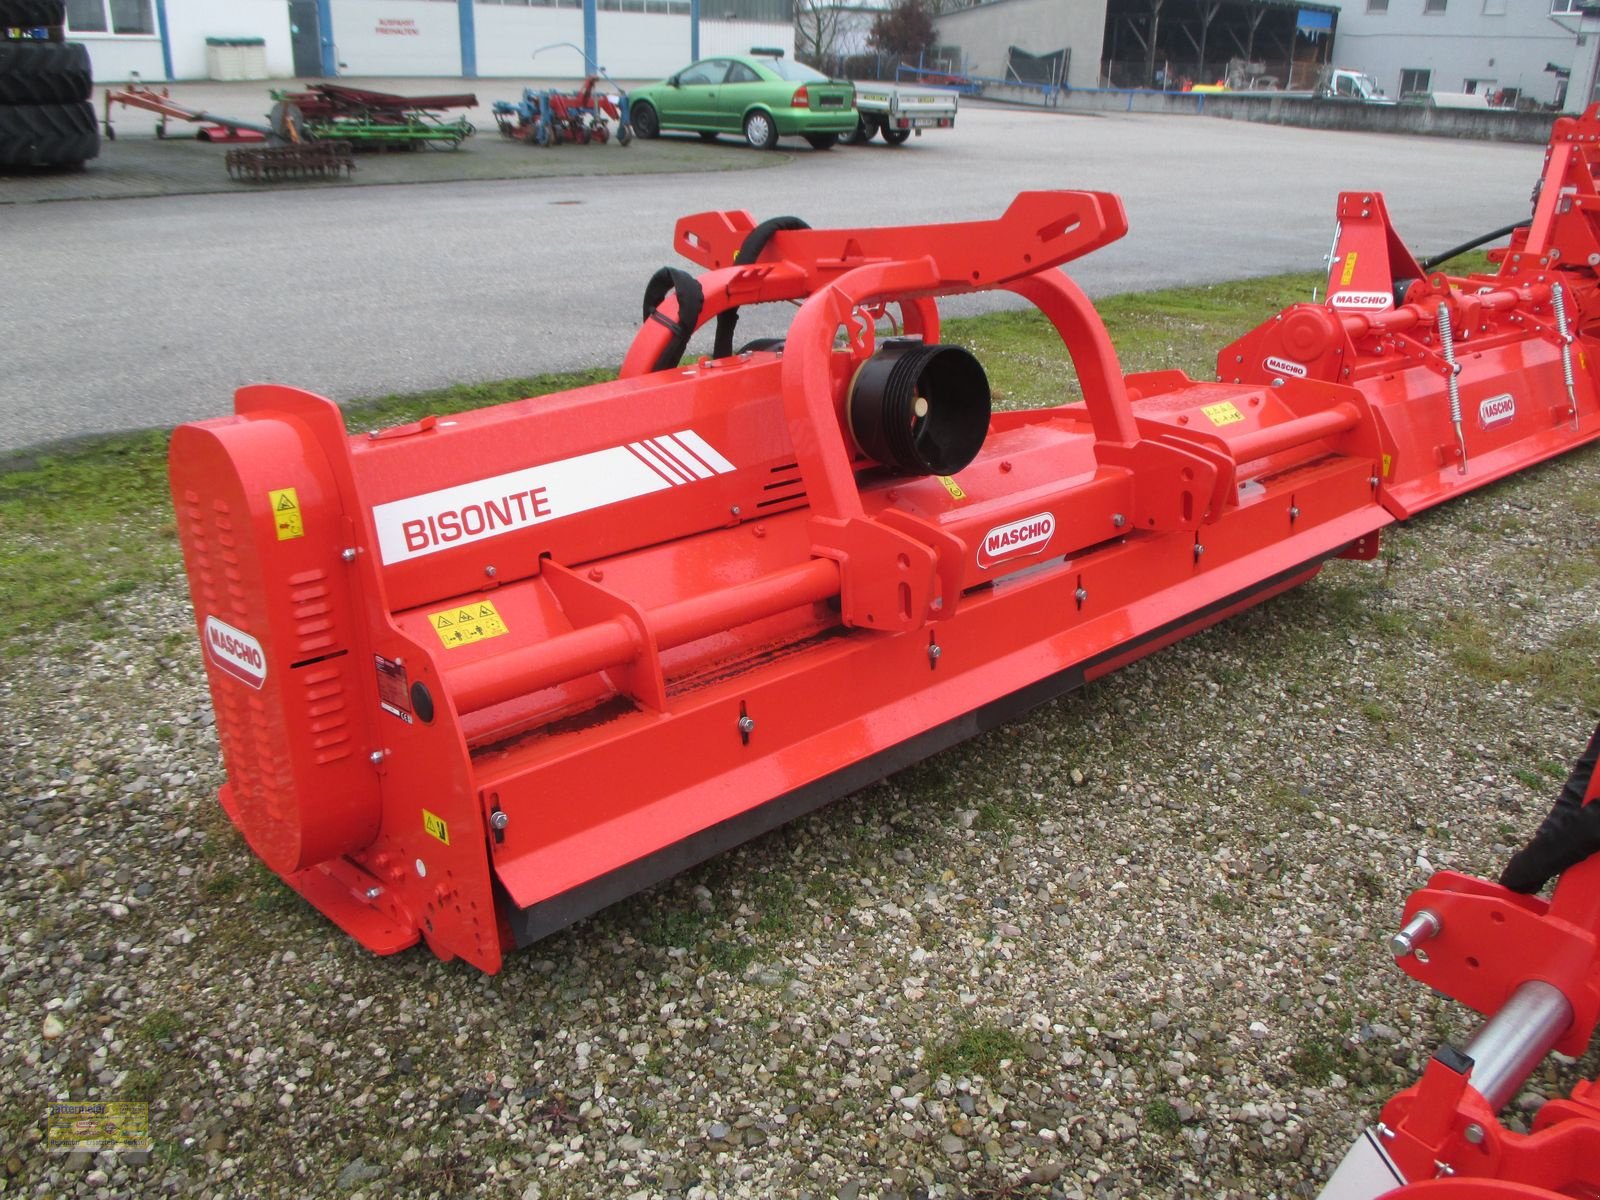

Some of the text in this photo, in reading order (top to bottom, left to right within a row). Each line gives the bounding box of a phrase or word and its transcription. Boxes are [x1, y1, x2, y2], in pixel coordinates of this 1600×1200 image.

[1336, 295, 1388, 305] MASCHIO
[1269, 359, 1304, 375] MASCHIO
[401, 485, 552, 553] BISONTE
[988, 519, 1051, 552] MASCHIO
[209, 625, 263, 670] MASCHIO
